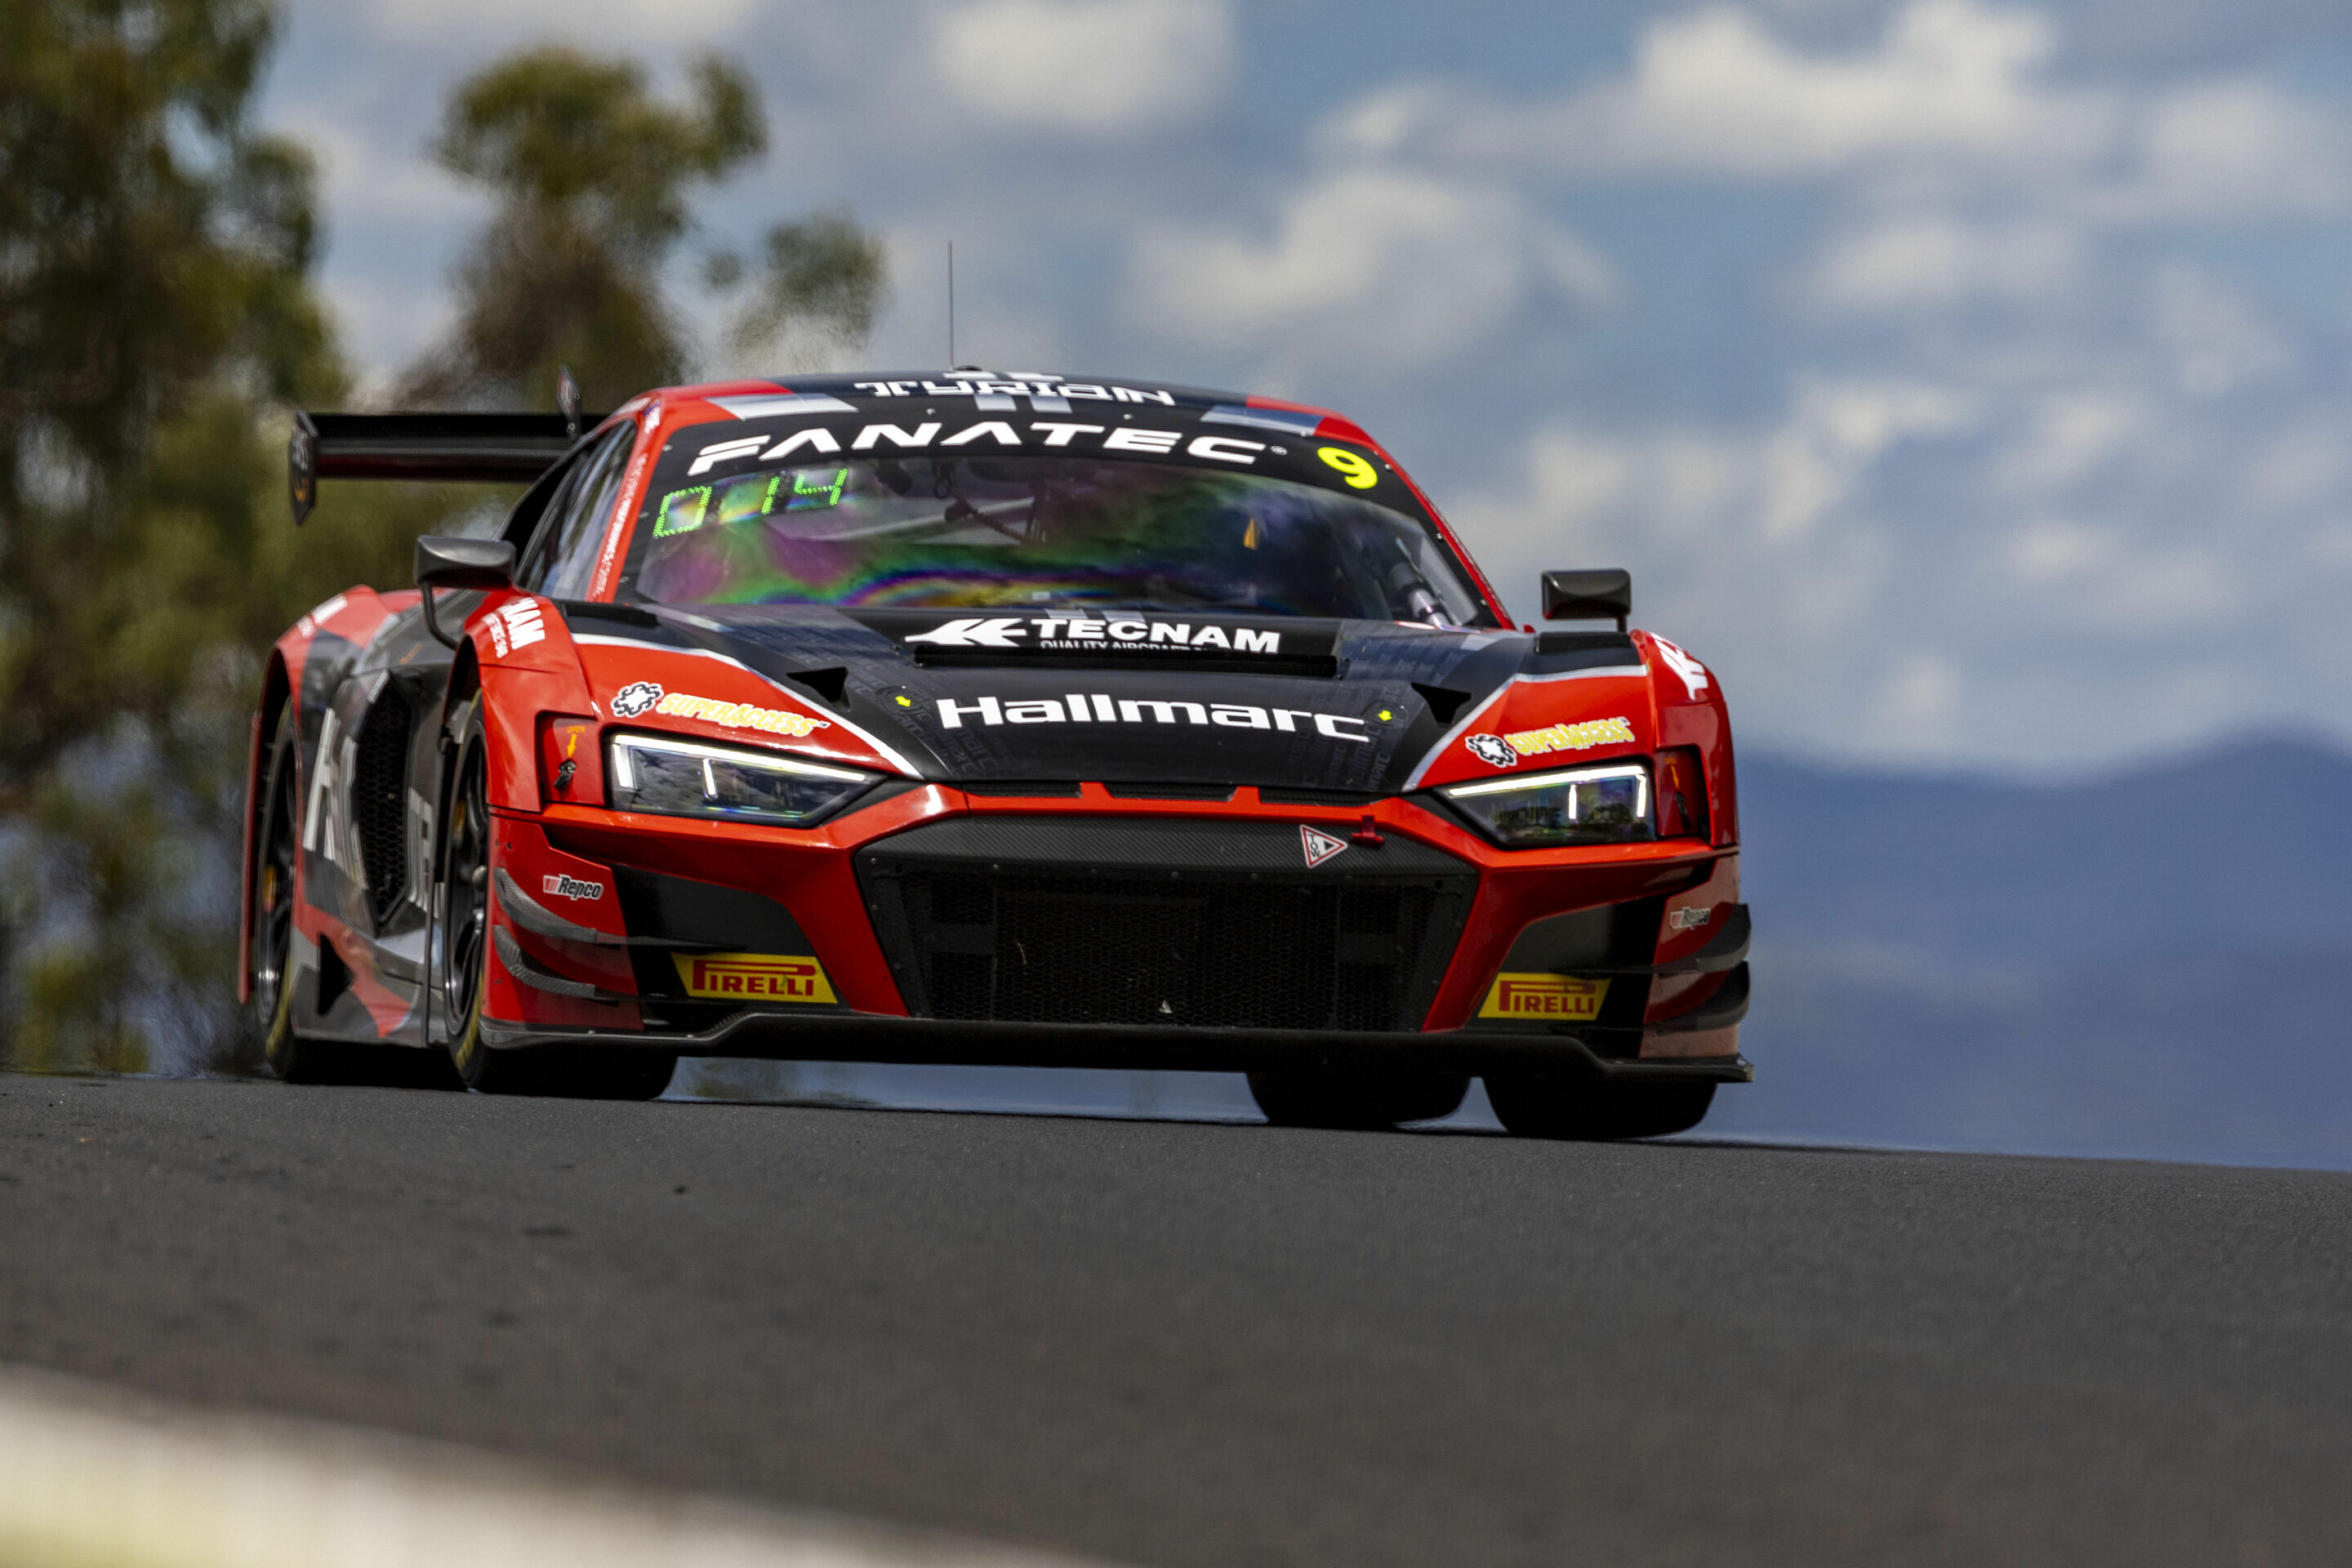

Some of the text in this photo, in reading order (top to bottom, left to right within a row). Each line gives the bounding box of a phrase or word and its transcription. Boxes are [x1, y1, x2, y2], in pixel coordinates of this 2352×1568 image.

[688, 422, 1266, 477] FANATEC
[1317, 447, 1379, 489] 9
[1031, 617, 1281, 653] TECNAM
[937, 693, 1370, 742] Hallmarc
[1308, 834, 1321, 858] TOW
[558, 876, 602, 899] Repco
[693, 960, 816, 996] PIRELLI
[1499, 980, 1596, 1014] PIRELLI
